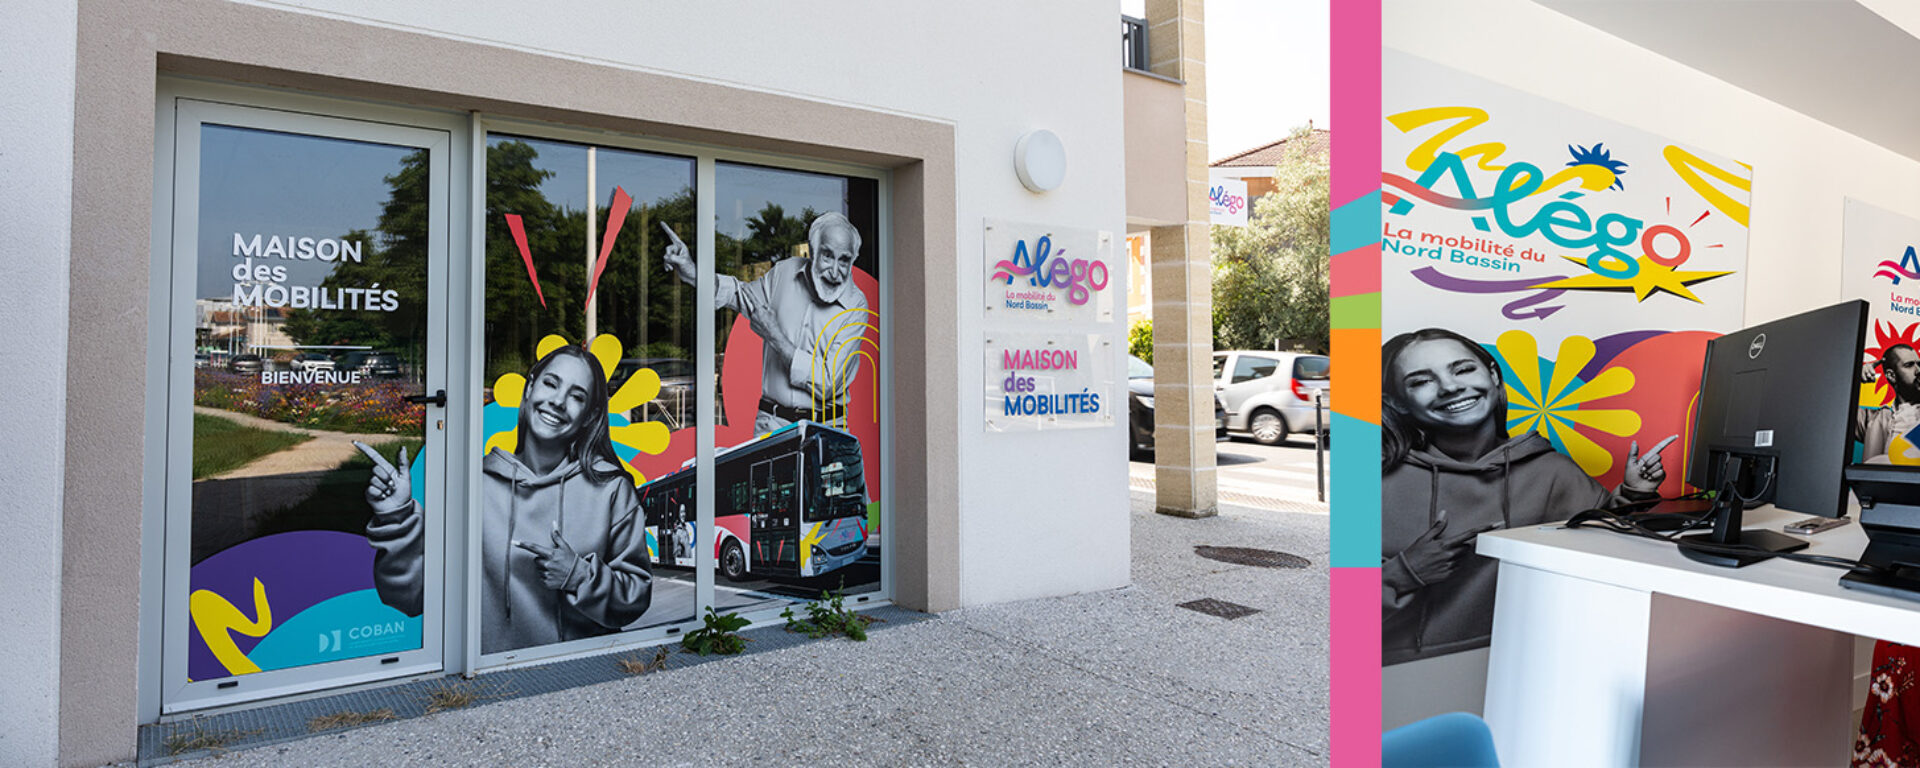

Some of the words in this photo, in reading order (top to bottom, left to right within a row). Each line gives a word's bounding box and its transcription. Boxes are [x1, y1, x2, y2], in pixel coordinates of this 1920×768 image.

[1382, 150, 1692, 280] Alégo
[232, 232, 362, 263] MAISON
[1383, 222, 1413, 240] La
[1420, 231, 1515, 258] mobilité
[1520, 247, 1546, 263] du
[1381, 237, 1443, 260] Nord
[1450, 248, 1522, 273] Bassin
[232, 258, 288, 282] des
[991, 235, 1109, 306] Alégo
[232, 282, 400, 312] MOBILITÉS
[1006, 289, 1016, 299] La
[1046, 292, 1057, 301] du
[1006, 299, 1025, 309] Nord
[1890, 291, 1903, 302] La
[1890, 302, 1914, 315] Nord
[1003, 348, 1078, 370] MAISON
[261, 370, 361, 385] BIENVENUE
[1003, 370, 1036, 393] des
[1003, 387, 1101, 417] MOBILITÉS
[348, 620, 405, 640] COBAN
